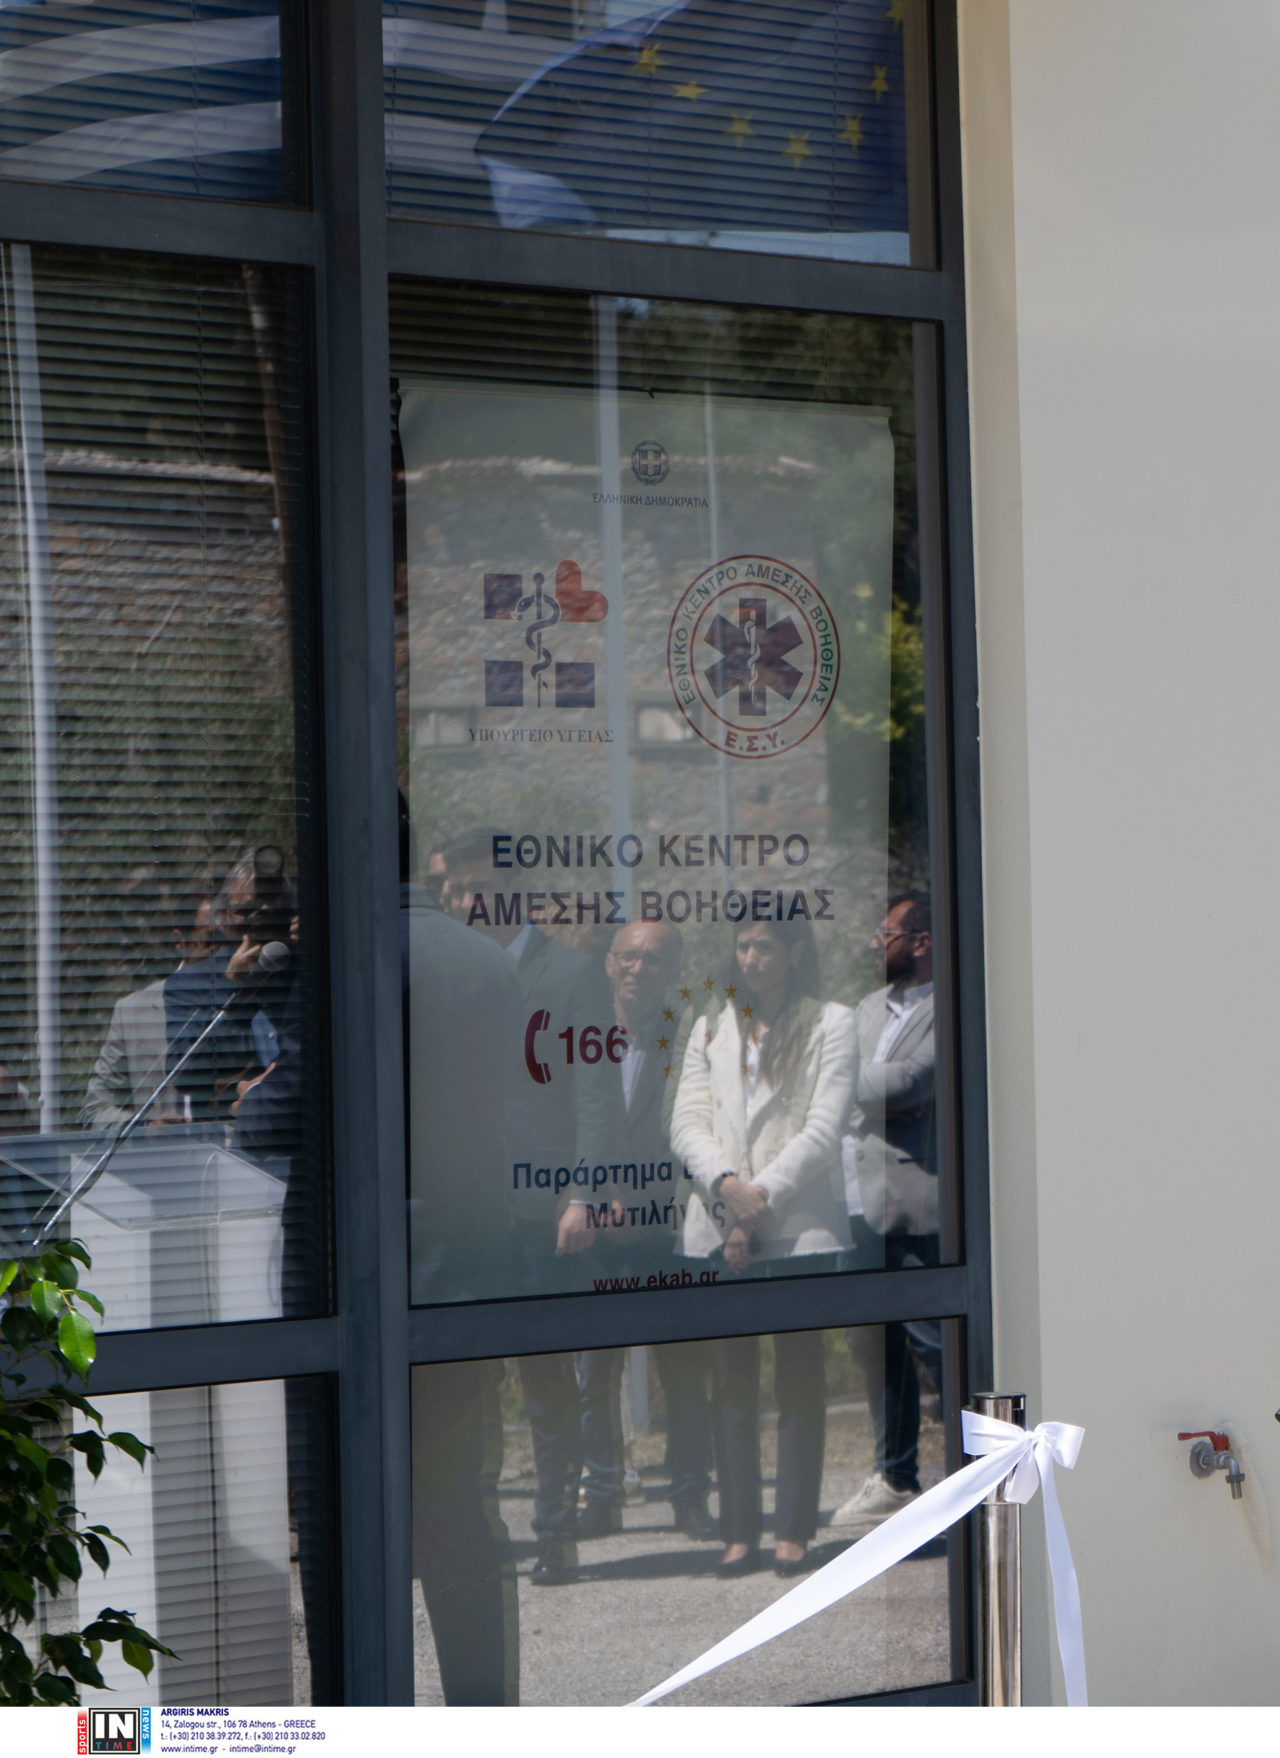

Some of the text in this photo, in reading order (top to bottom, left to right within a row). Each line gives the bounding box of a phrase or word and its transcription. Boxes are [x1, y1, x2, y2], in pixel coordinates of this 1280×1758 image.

[593, 493, 709, 508] ΕΛΛΗΝΙΚΗ ΔΗΜΟΚΡΑΤΙΑ
[674, 564, 834, 707] ΕΘΝΙΚΟ ΚΕΝΤΡΟ ΑΜΕΣΗΣ ΒΟΗΘΕΙΑΣ
[469, 728, 614, 743] ΥΠΟΥΡΓΕΙΟ ΥΓΕΙΑΣ
[724, 730, 786, 752] Ε.Σ.Υ.
[491, 833, 811, 868] ΕΘΝΙΚΟ ΚΕΝΤΡΟ
[466, 888, 836, 926] ΑΜΕΣΗΣ ΒΟΗΘΕΙΑΣ
[558, 1025, 629, 1065] 166
[512, 1158, 673, 1194] Παράρτημα
